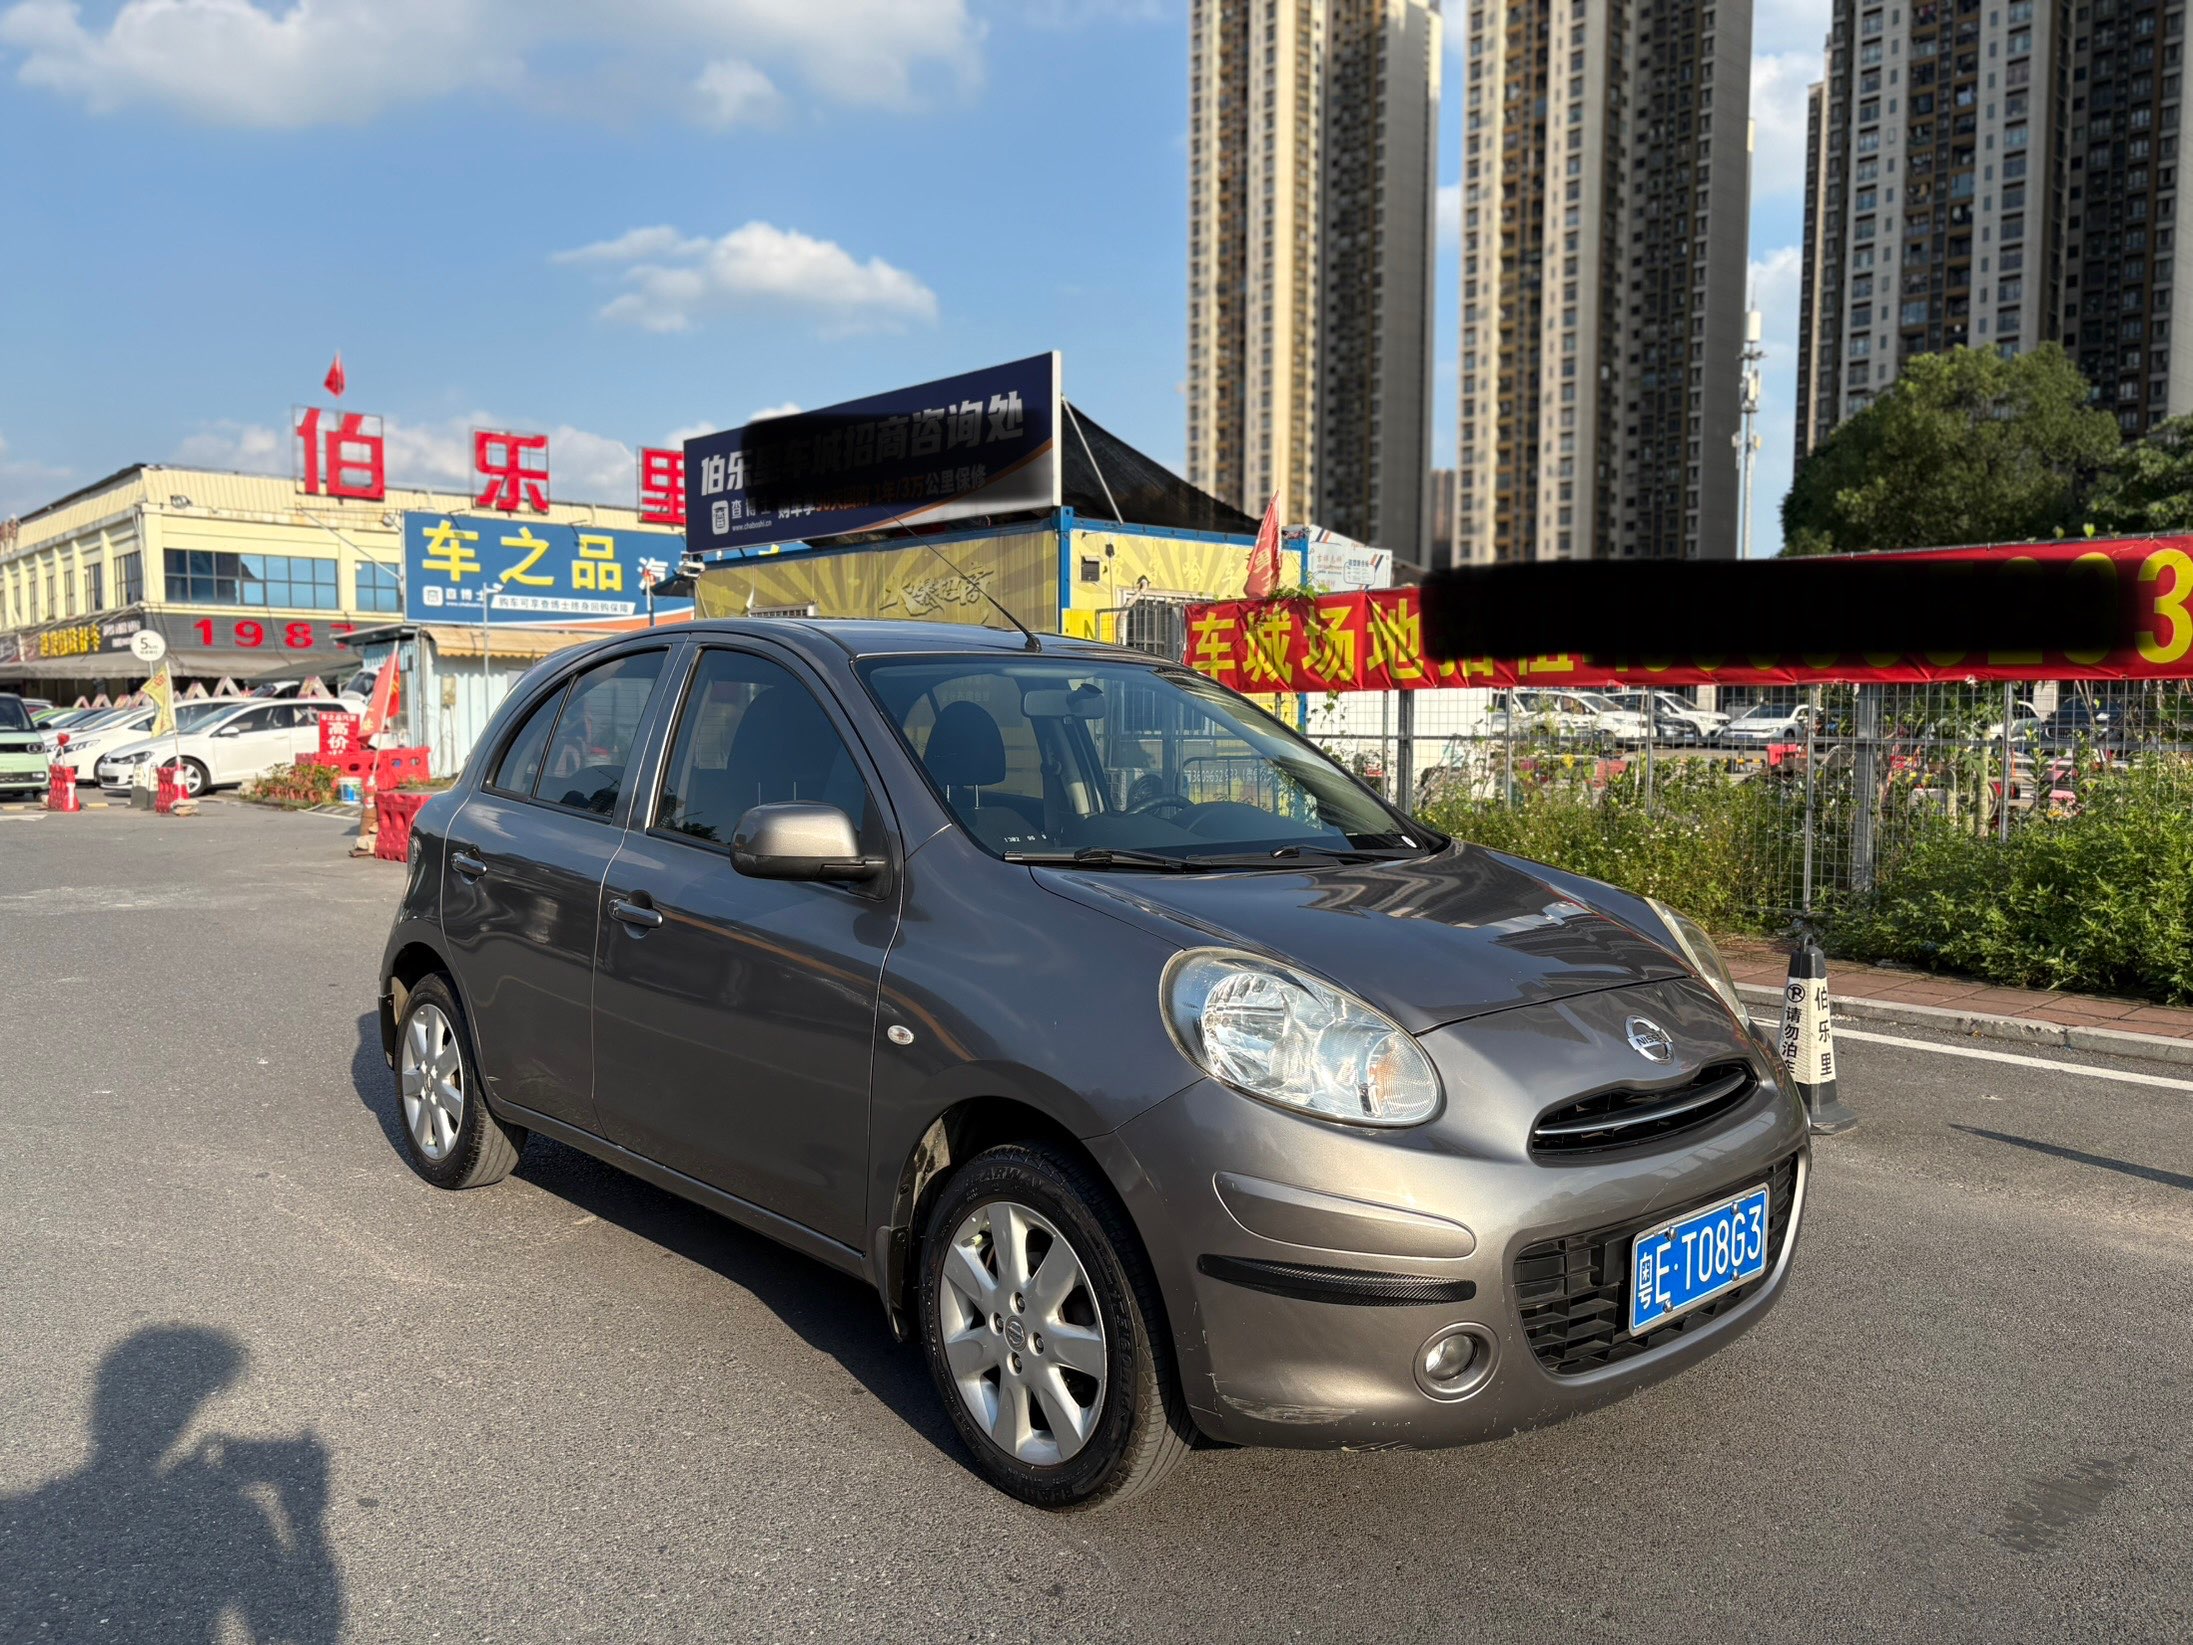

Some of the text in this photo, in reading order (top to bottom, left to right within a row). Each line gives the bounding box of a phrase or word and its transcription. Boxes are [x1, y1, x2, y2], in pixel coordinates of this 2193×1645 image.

[422, 519, 622, 592] 车之品
[1814, 986, 1832, 1076] 伯乐里
